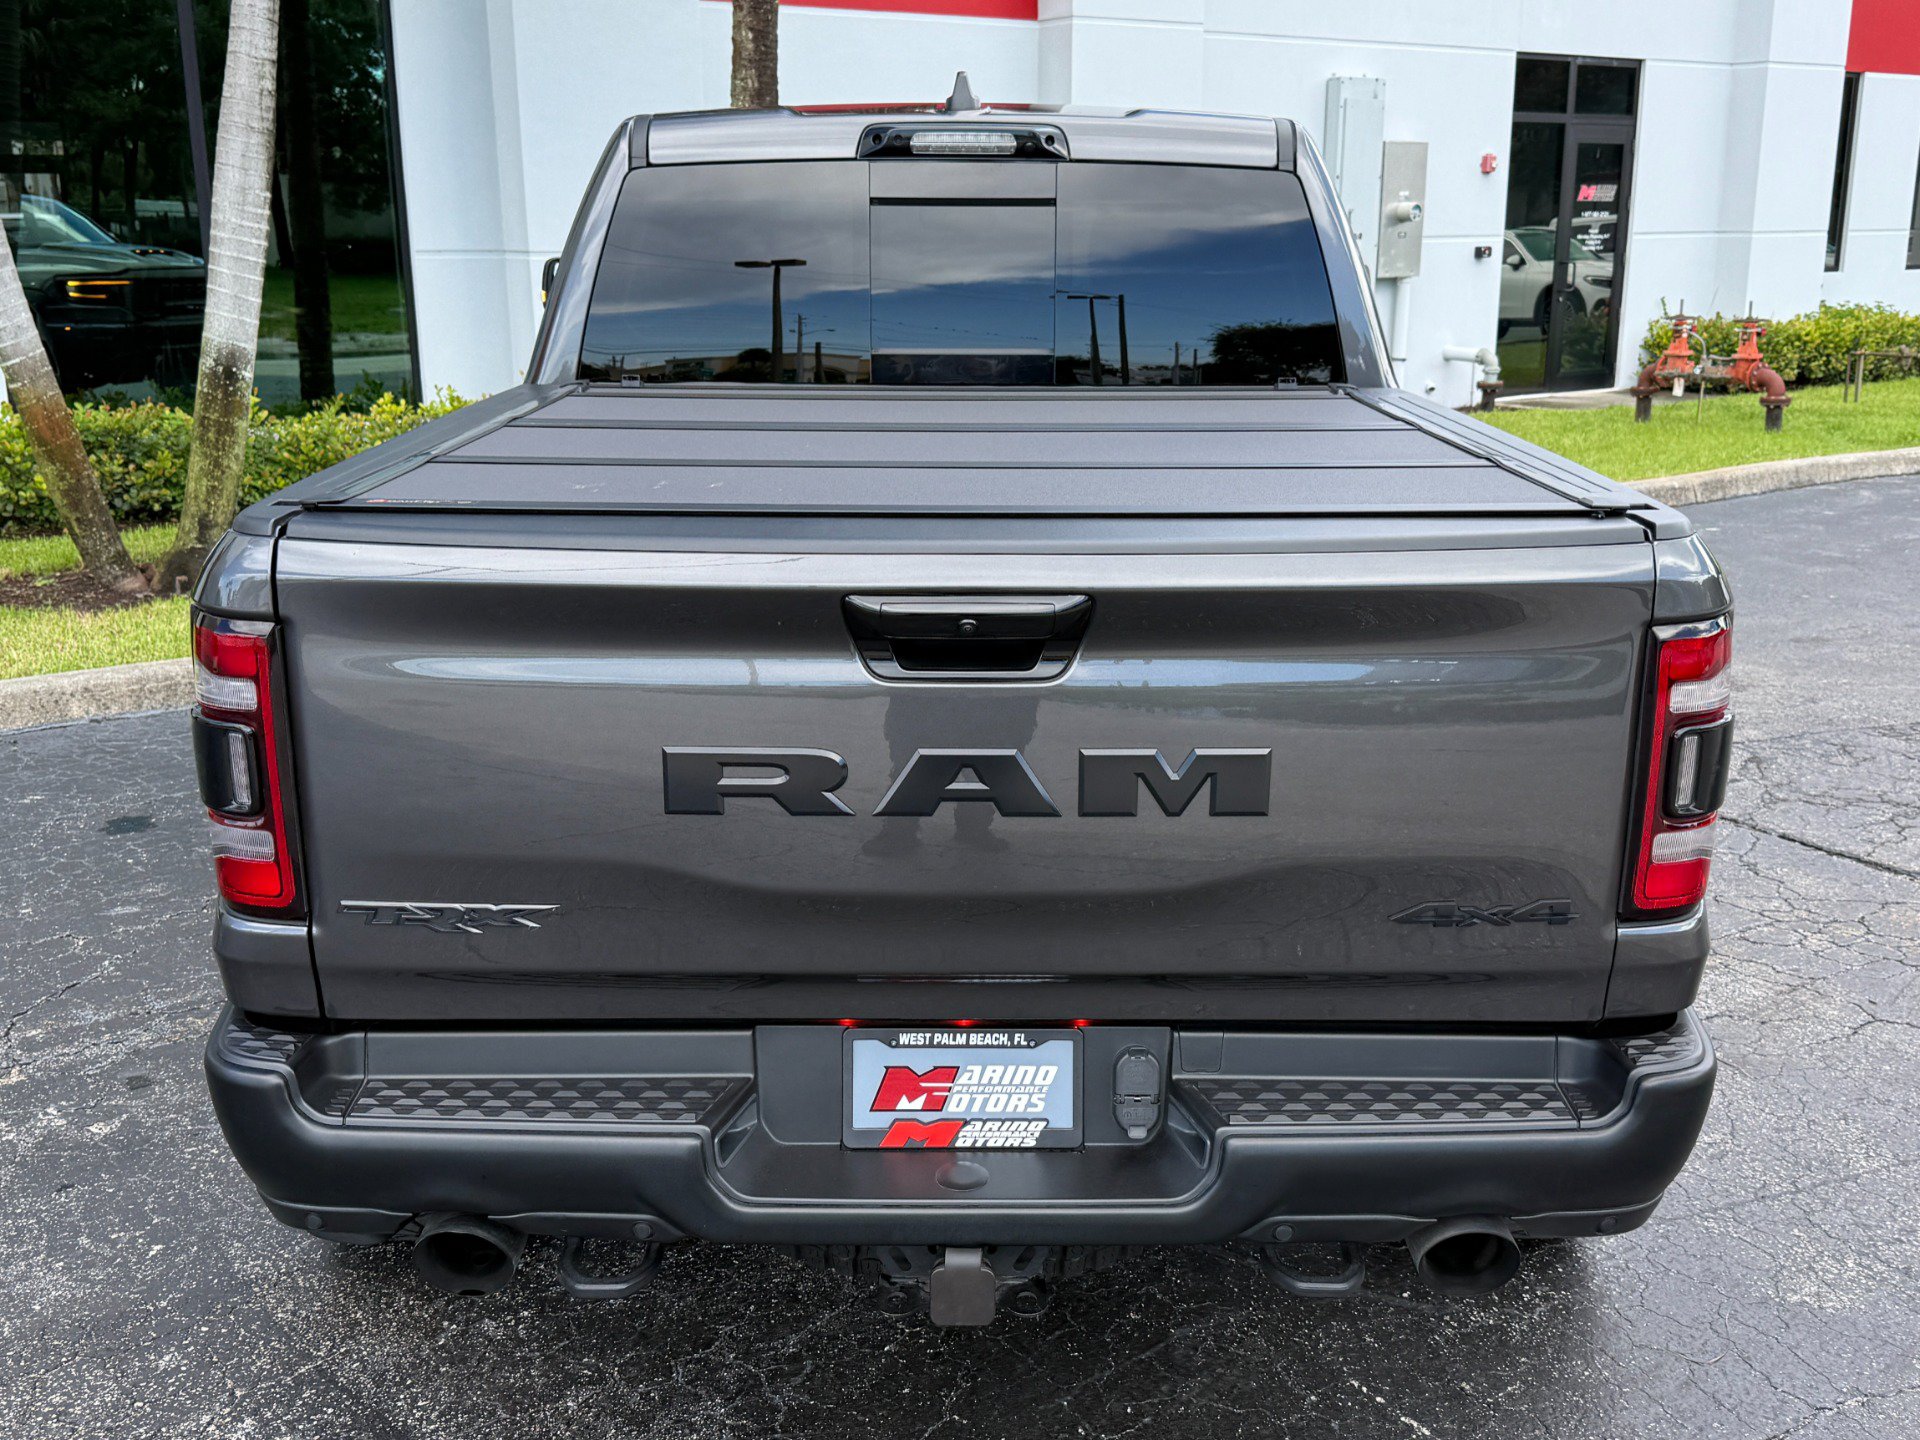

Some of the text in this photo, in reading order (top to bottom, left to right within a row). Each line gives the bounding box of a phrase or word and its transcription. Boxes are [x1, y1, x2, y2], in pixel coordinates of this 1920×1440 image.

[661, 746, 1273, 817] RAM
[339, 899, 561, 935] TRX
[899, 1032, 1028, 1047] WEST PALM BEACH, FL
